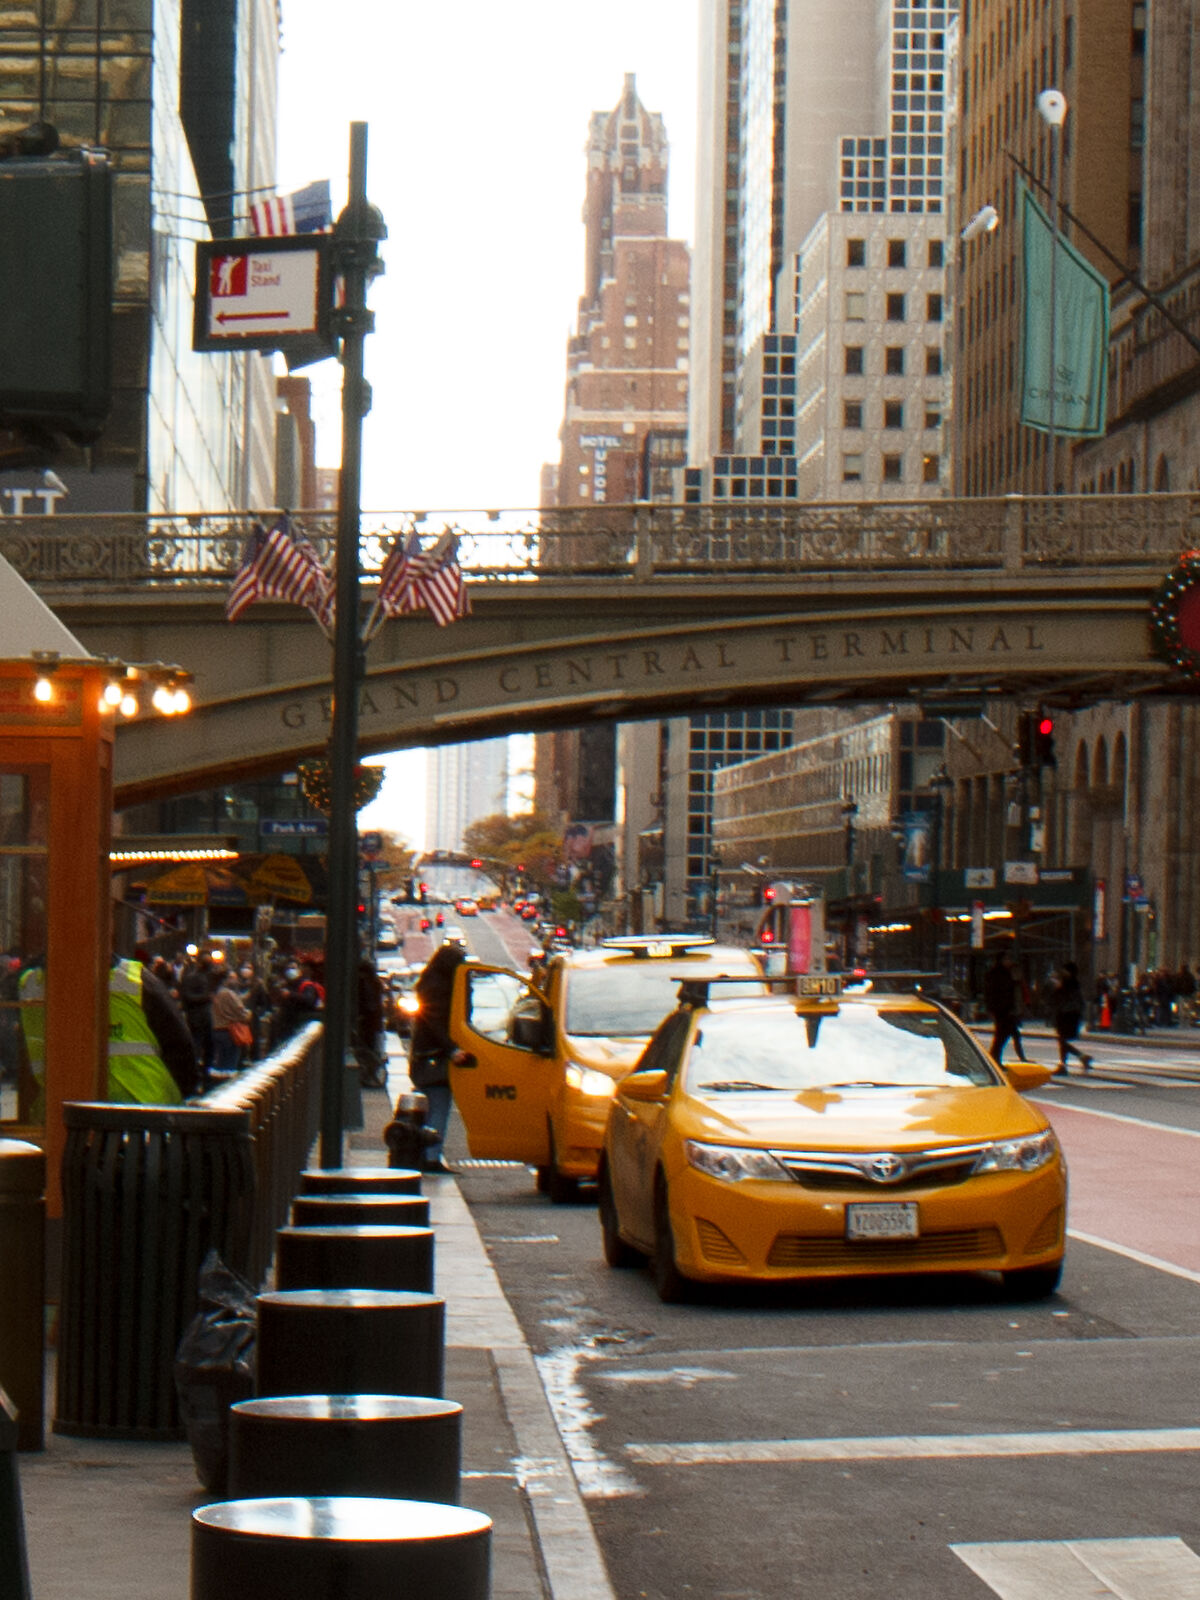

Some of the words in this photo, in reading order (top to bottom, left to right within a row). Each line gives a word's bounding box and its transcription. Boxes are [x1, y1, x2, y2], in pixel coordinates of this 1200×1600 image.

[252, 259, 272, 272] Taxi
[251, 274, 280, 287] Stand
[498, 642, 735, 693] CENTRAL
[774, 624, 1045, 662] TERMINAL
[484, 1084, 517, 1101] NYC
